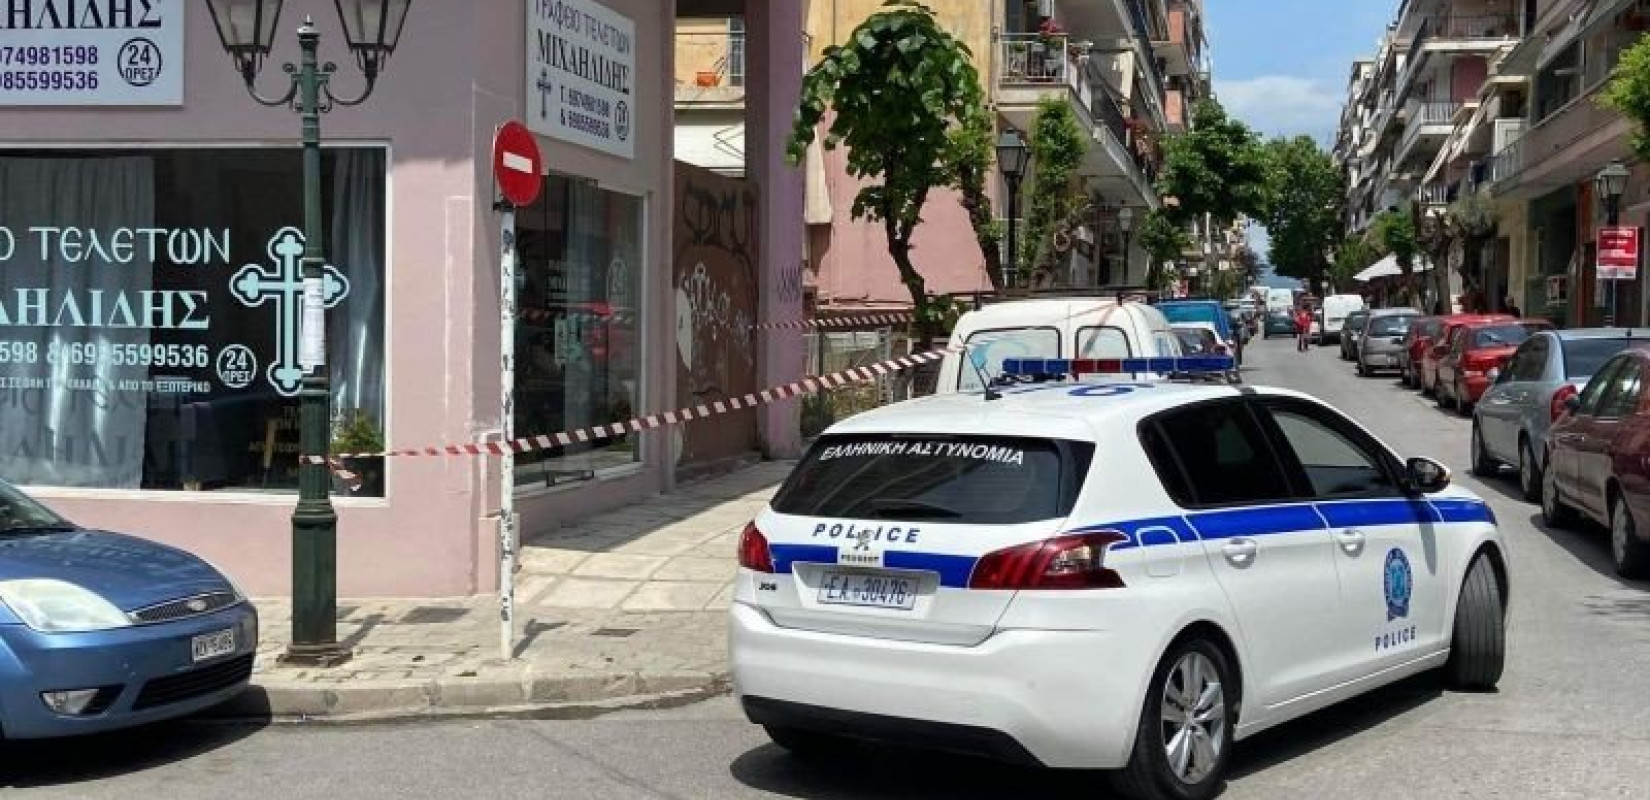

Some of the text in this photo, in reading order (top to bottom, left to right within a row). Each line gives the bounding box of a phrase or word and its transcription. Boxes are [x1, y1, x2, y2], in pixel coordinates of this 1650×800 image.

[0, 0, 162, 29] ΗΛΙΔΗΣ
[0, 46, 98, 65] 74981598
[127, 45, 150, 65] 24
[537, 28, 629, 95] ΜΙΧΑΗΛΙΔΗΣ
[0, 71, 98, 90] 85599536
[29, 226, 230, 264] ΤΕΛΕΤΩΝ
[71, 343, 209, 367] 695599536
[226, 350, 248, 369] 24
[906, 442, 1025, 465] ΑΣΤΥΝΟΜΙΑ
[812, 523, 921, 544] POLICE
[1374, 625, 1416, 652] POLICE
